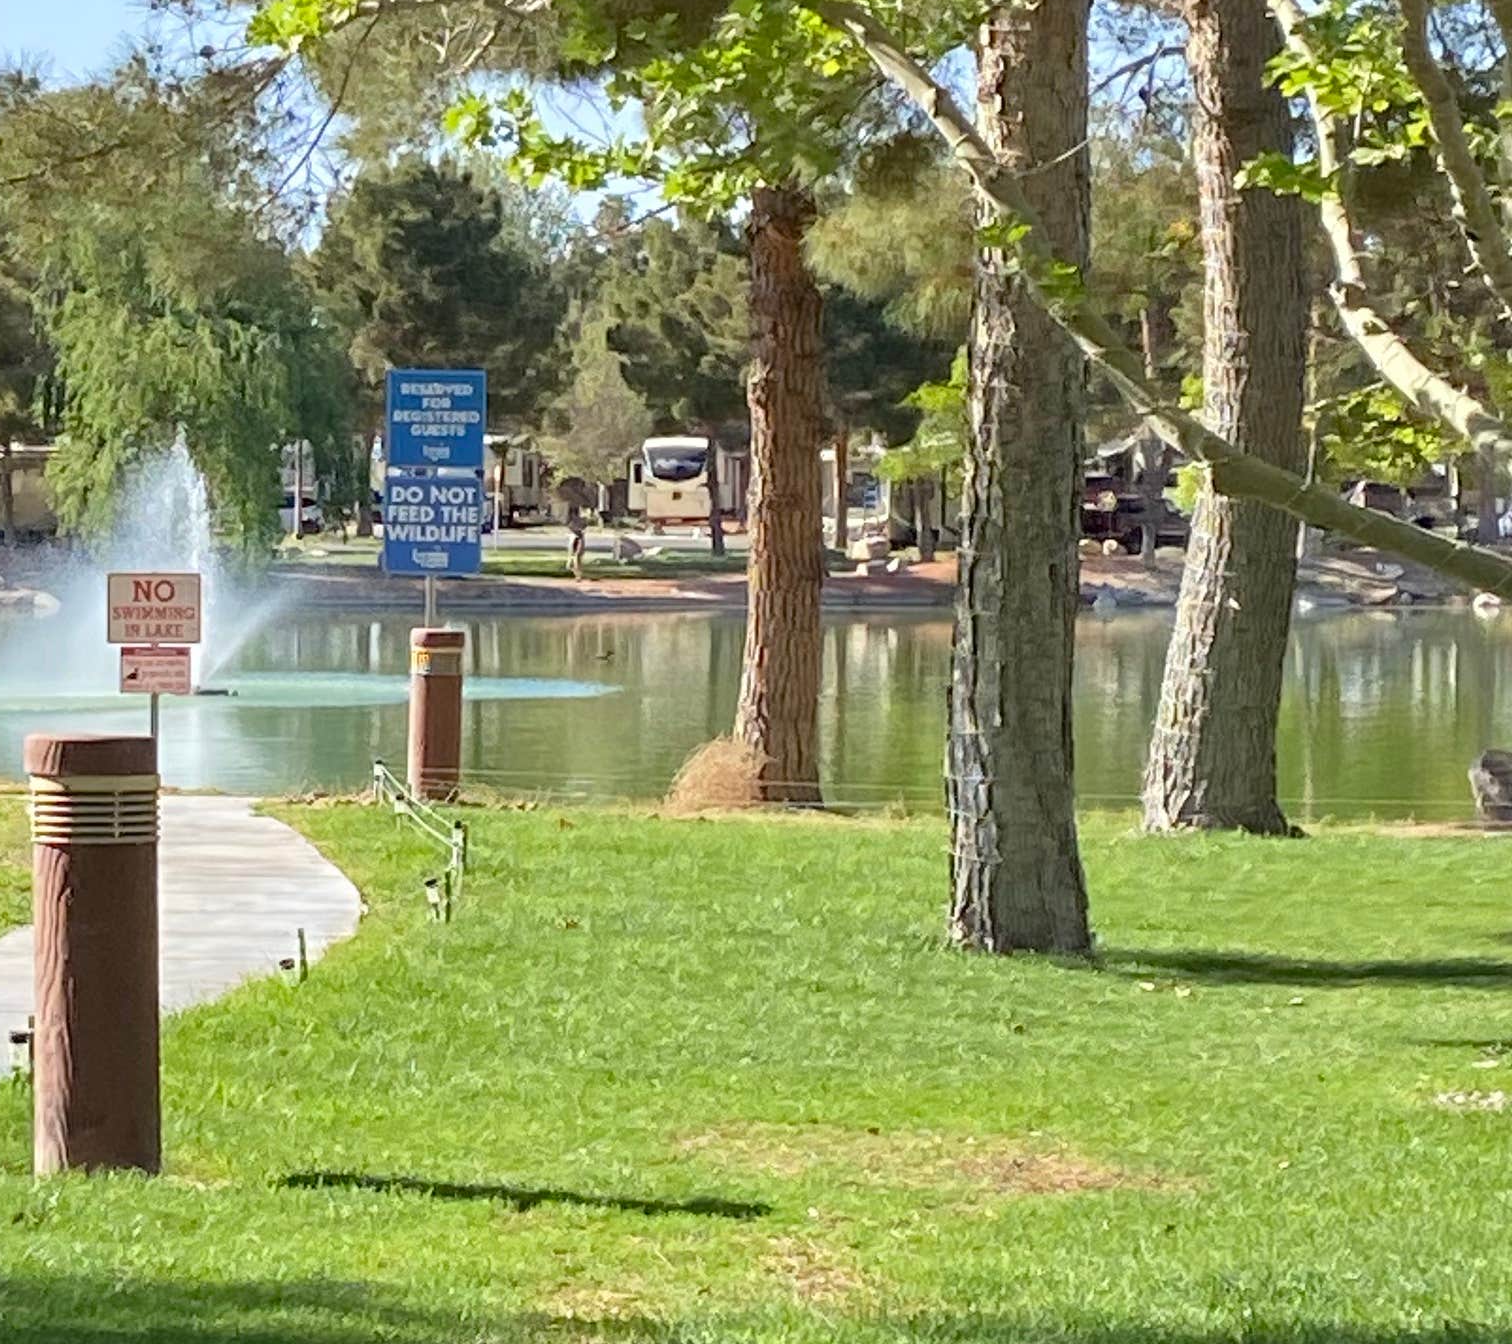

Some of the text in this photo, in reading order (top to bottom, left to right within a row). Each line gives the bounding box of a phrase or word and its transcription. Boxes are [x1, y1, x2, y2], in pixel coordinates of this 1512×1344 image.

[422, 397, 451, 409] FOR
[392, 409, 481, 424] REGISTERED
[410, 424, 466, 437] GUESTS
[391, 485, 476, 505] DO NOT
[388, 505, 478, 524] FEED THE
[387, 524, 478, 543] WILDLIFE
[132, 580, 175, 602] NO
[112, 607, 195, 620] SWIMMING
[145, 623, 184, 638] LAKE
